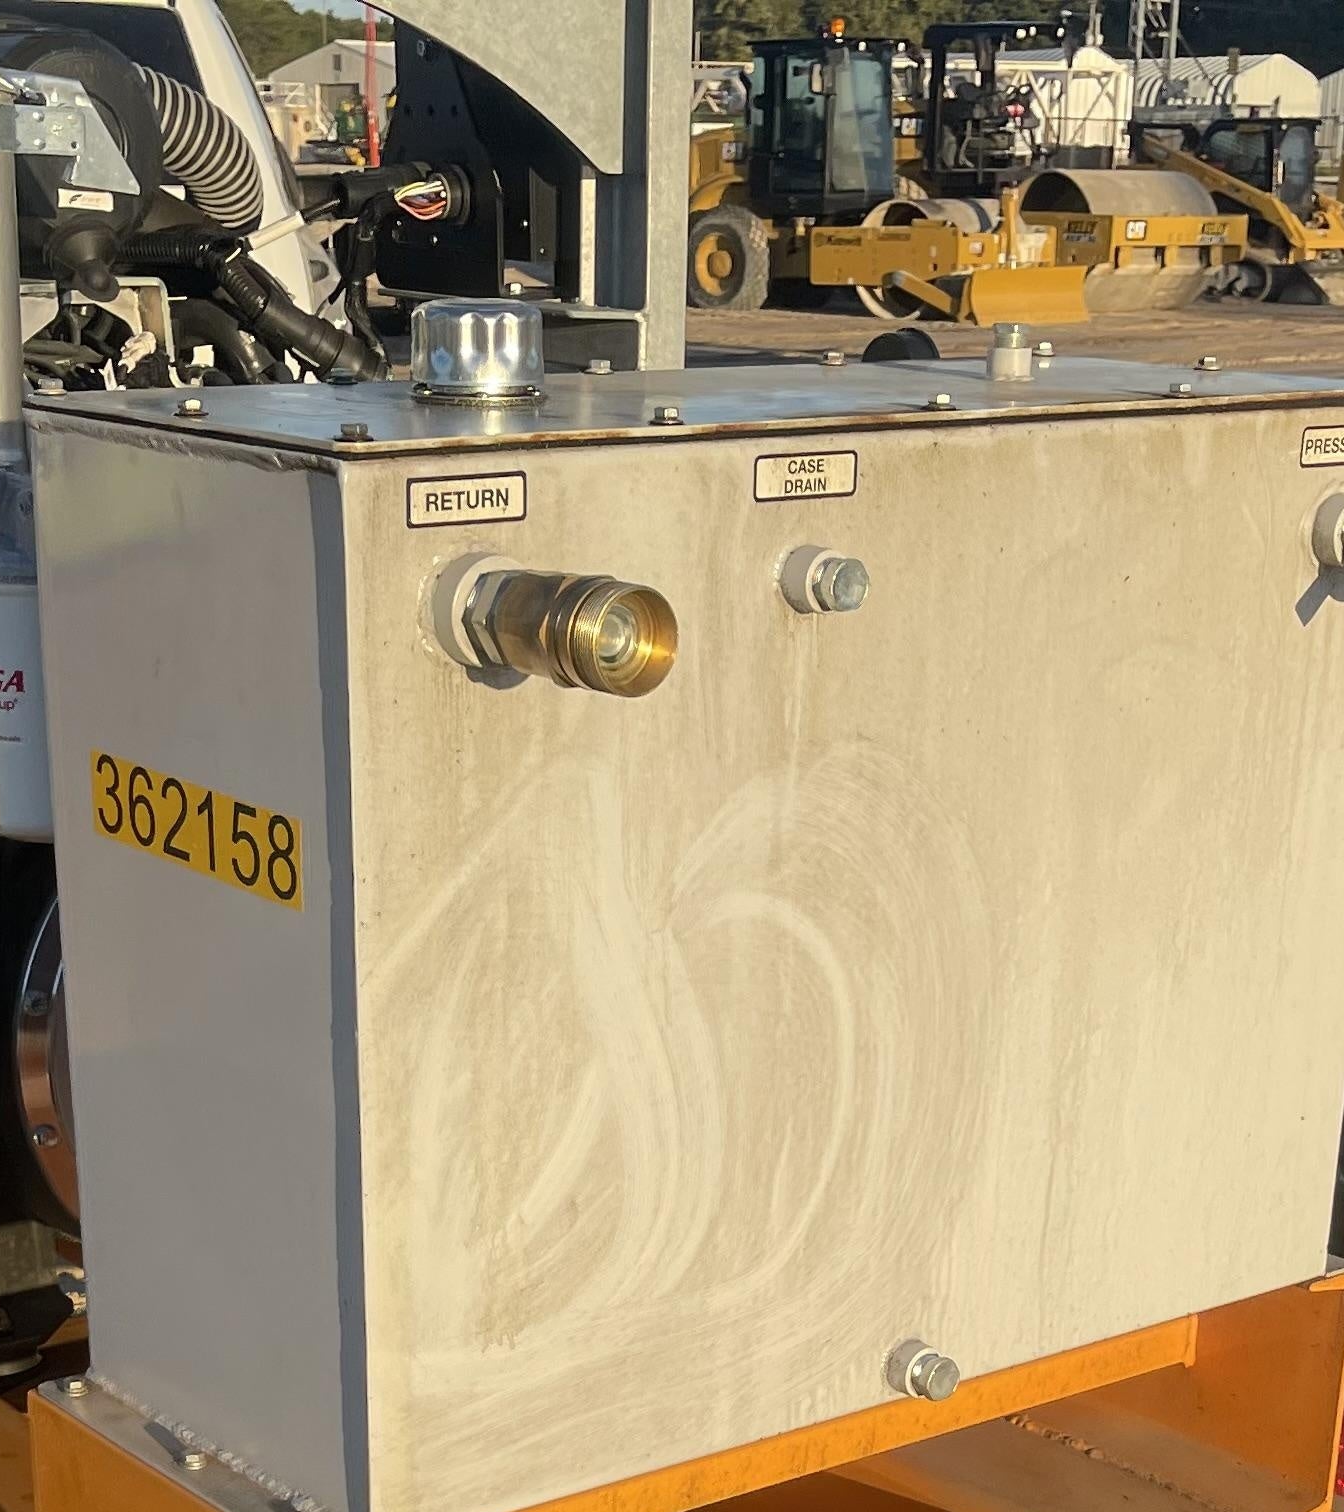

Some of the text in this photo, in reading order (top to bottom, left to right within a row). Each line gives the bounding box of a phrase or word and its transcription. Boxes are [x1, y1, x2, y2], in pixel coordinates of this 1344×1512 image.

[787, 459, 825, 474] CASE
[784, 477, 827, 494] DRAIN
[425, 488, 509, 512] RETURN
[96, 754, 297, 900] 362158
